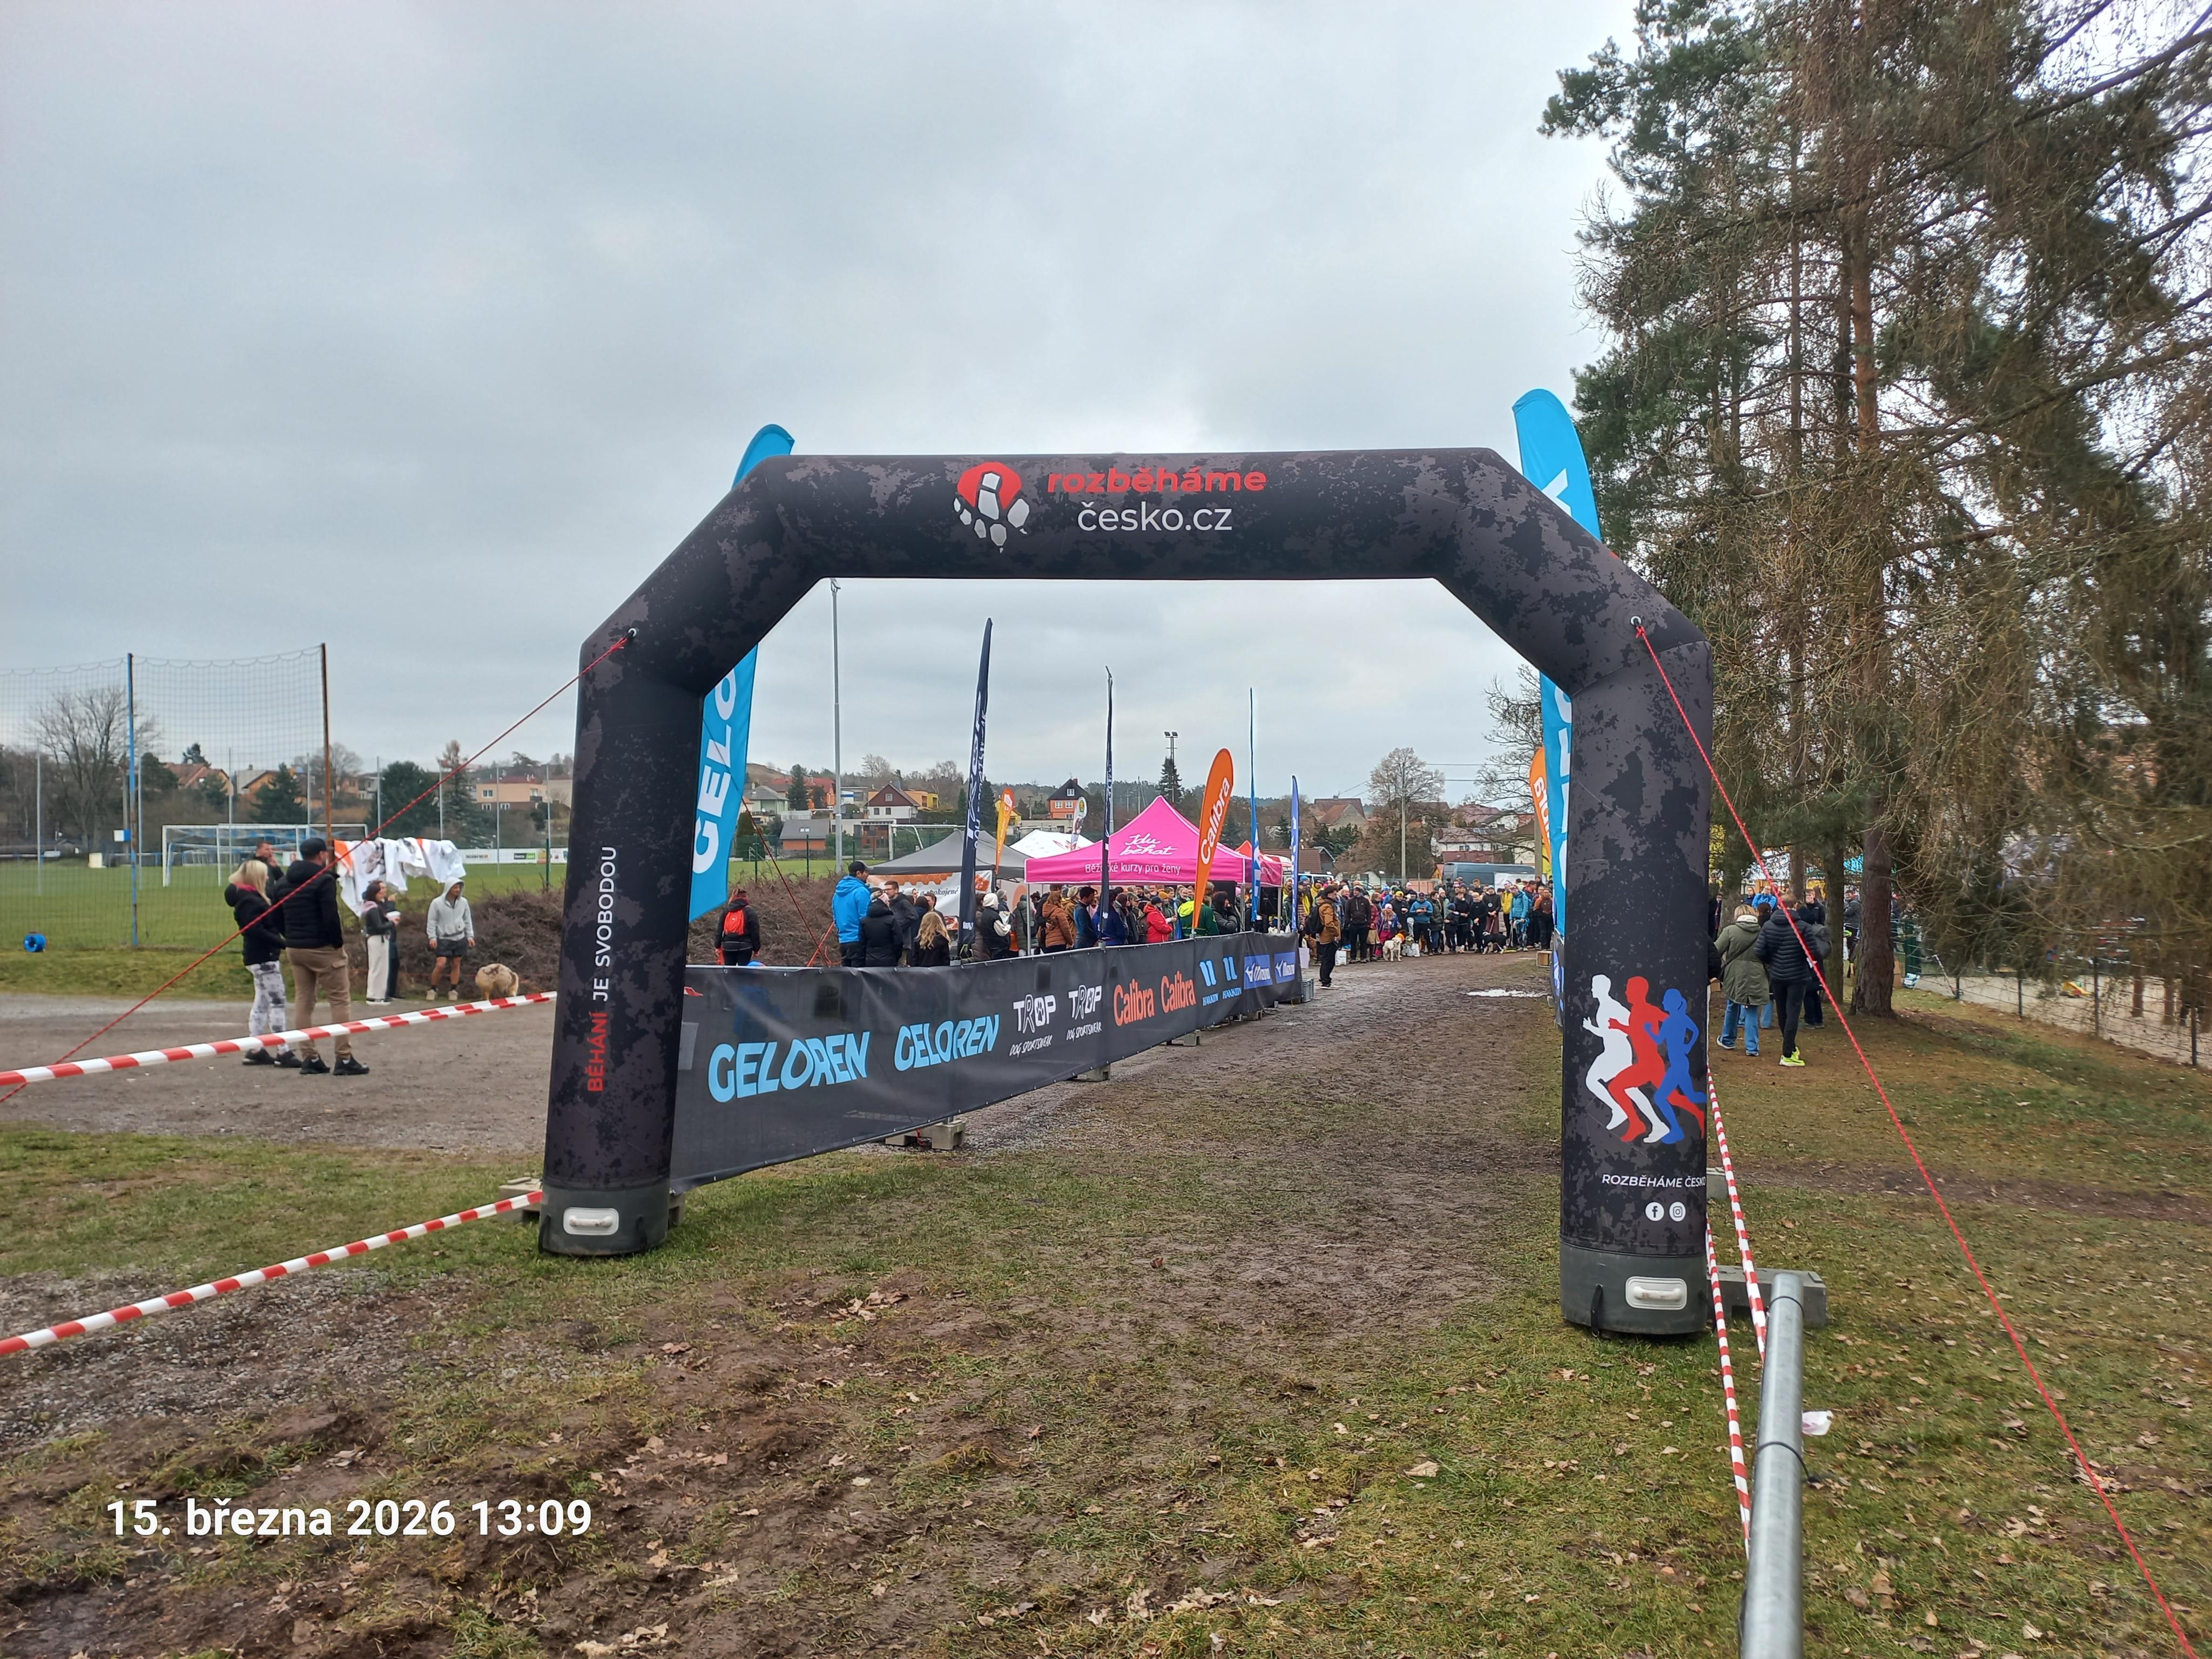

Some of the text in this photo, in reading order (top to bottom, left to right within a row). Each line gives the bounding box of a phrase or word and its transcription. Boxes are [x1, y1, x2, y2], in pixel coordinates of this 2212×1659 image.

[1048, 467, 1266, 492] rozběháme
[1078, 501, 1232, 531] česko.cz
[1201, 778, 1230, 864] Calibra
[1085, 862, 1181, 875] Běžké kurzy pro ženy
[588, 846, 617, 1092] BĚHÁNÍ JE SVOBODOU
[1113, 970, 1197, 1027] Calibra Calibra
[708, 1014, 1000, 1103] GELOREN GELOREN
[1602, 1174, 1706, 1188] ROZBĚHÁME ČESKO
